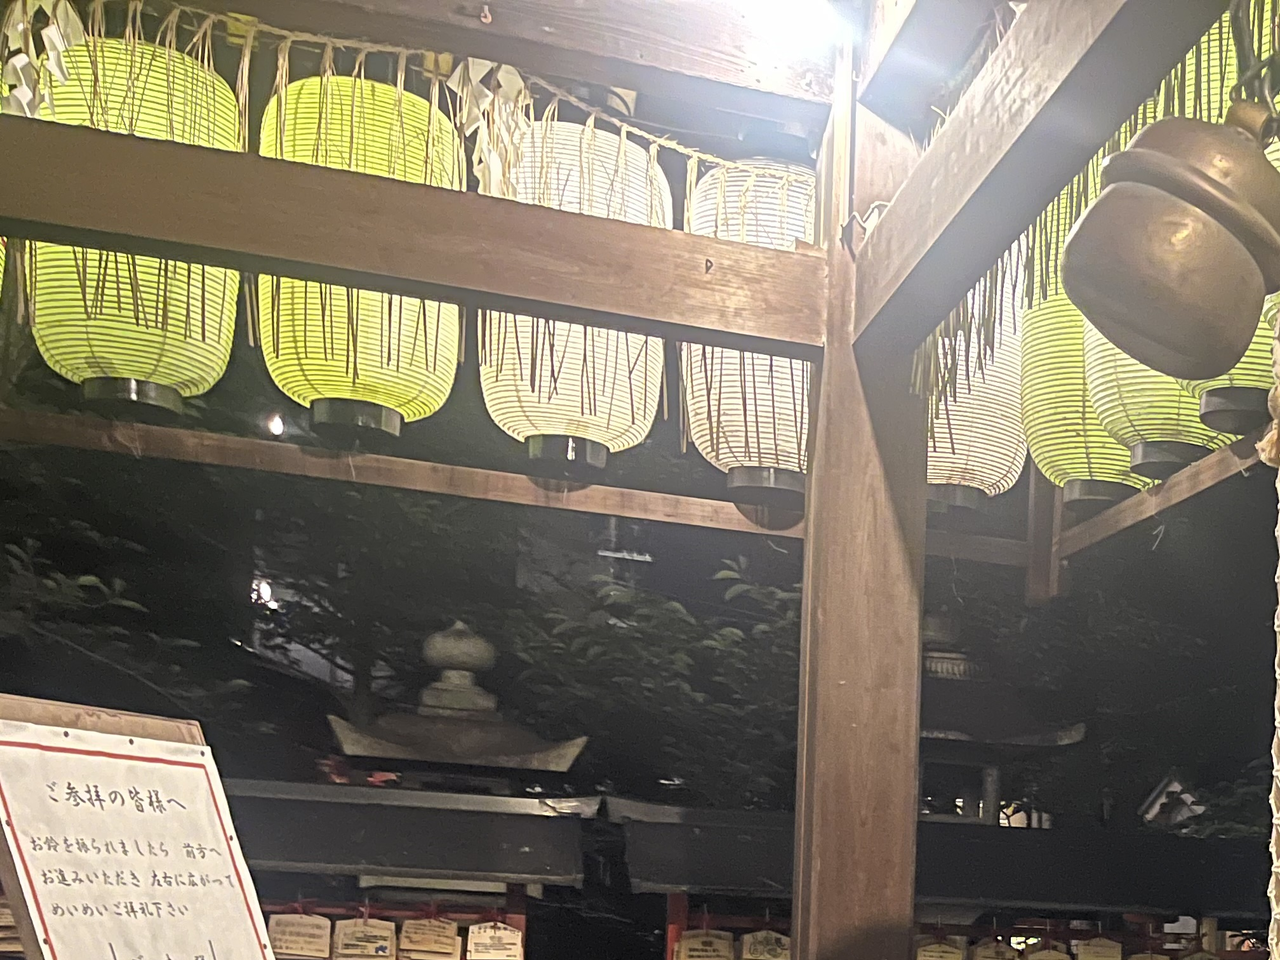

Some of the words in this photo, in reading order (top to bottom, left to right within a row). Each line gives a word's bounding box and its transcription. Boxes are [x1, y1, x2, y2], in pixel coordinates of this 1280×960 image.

[46, 781, 187, 814] ご参拝の皆様へ
[30, 836, 169, 857] お鈴を振られましたら
[182, 842, 222, 860] 前方へ
[41, 868, 141, 887] お進みいただき
[150, 870, 234, 888] 左右に広がって
[51, 901, 189, 919] めいめいご拝礼下さい
